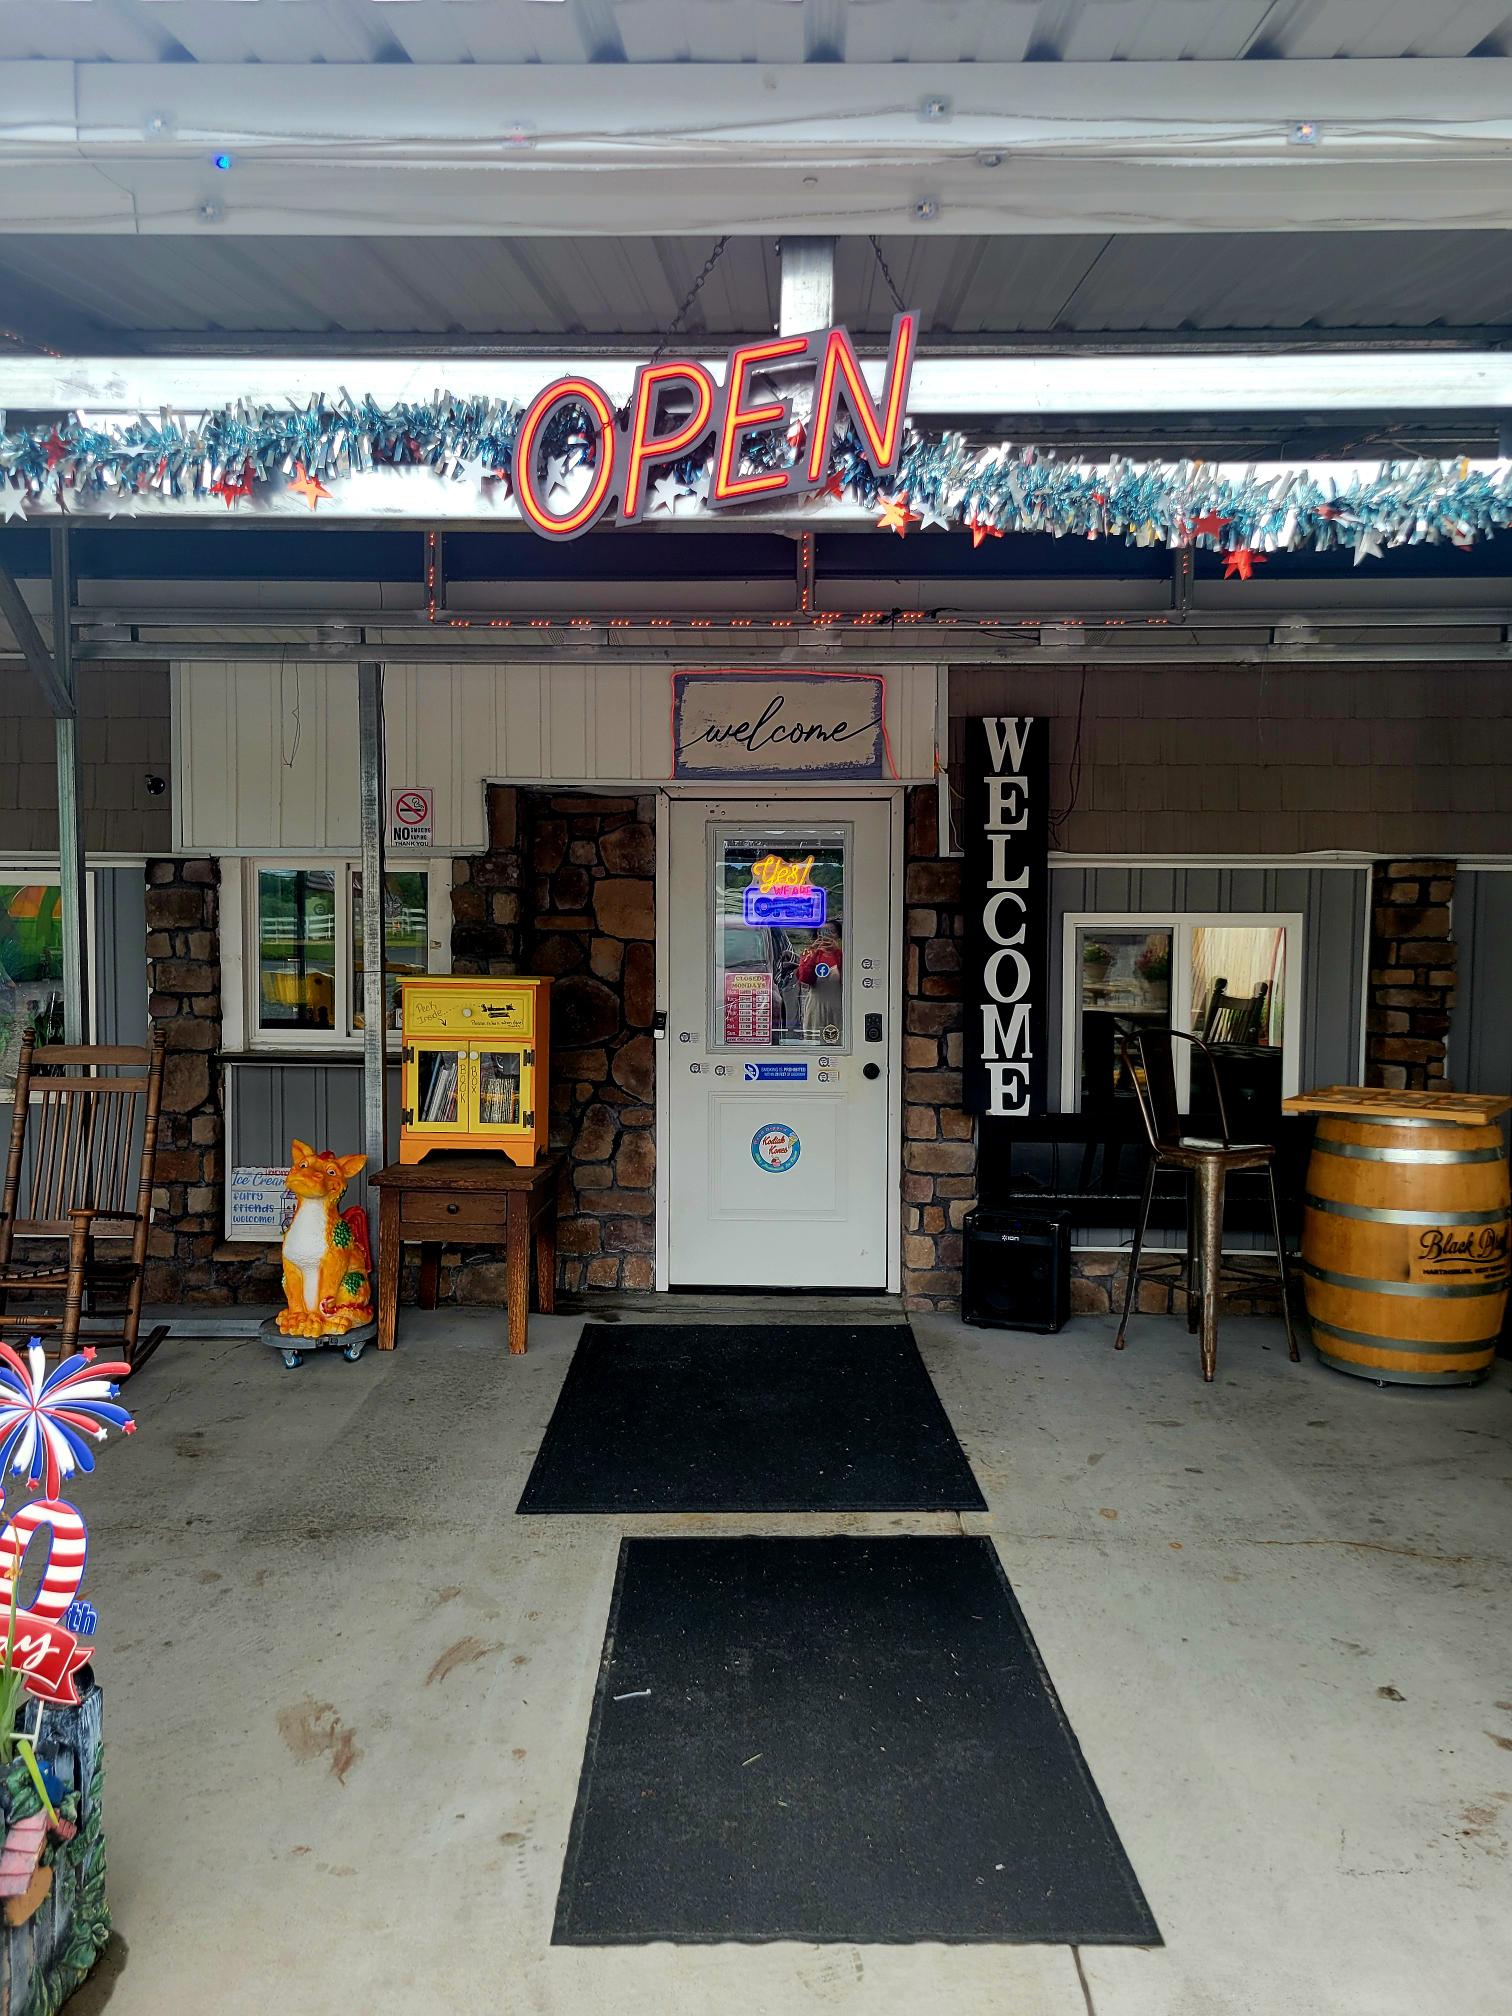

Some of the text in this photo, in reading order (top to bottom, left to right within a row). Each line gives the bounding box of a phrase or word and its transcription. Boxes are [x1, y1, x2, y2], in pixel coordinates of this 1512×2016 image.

[514, 312, 914, 537] OPEN
[676, 695, 882, 751] welcome
[393, 827, 410, 841] NO
[752, 854, 814, 895] Yes!
[980, 716, 1034, 1117] WELCOME
[762, 1135, 786, 1145] Kodiak
[232, 1171, 250, 1186] Ice
[1417, 1229, 1476, 1260] Black
[67, 1600, 98, 1635] th
